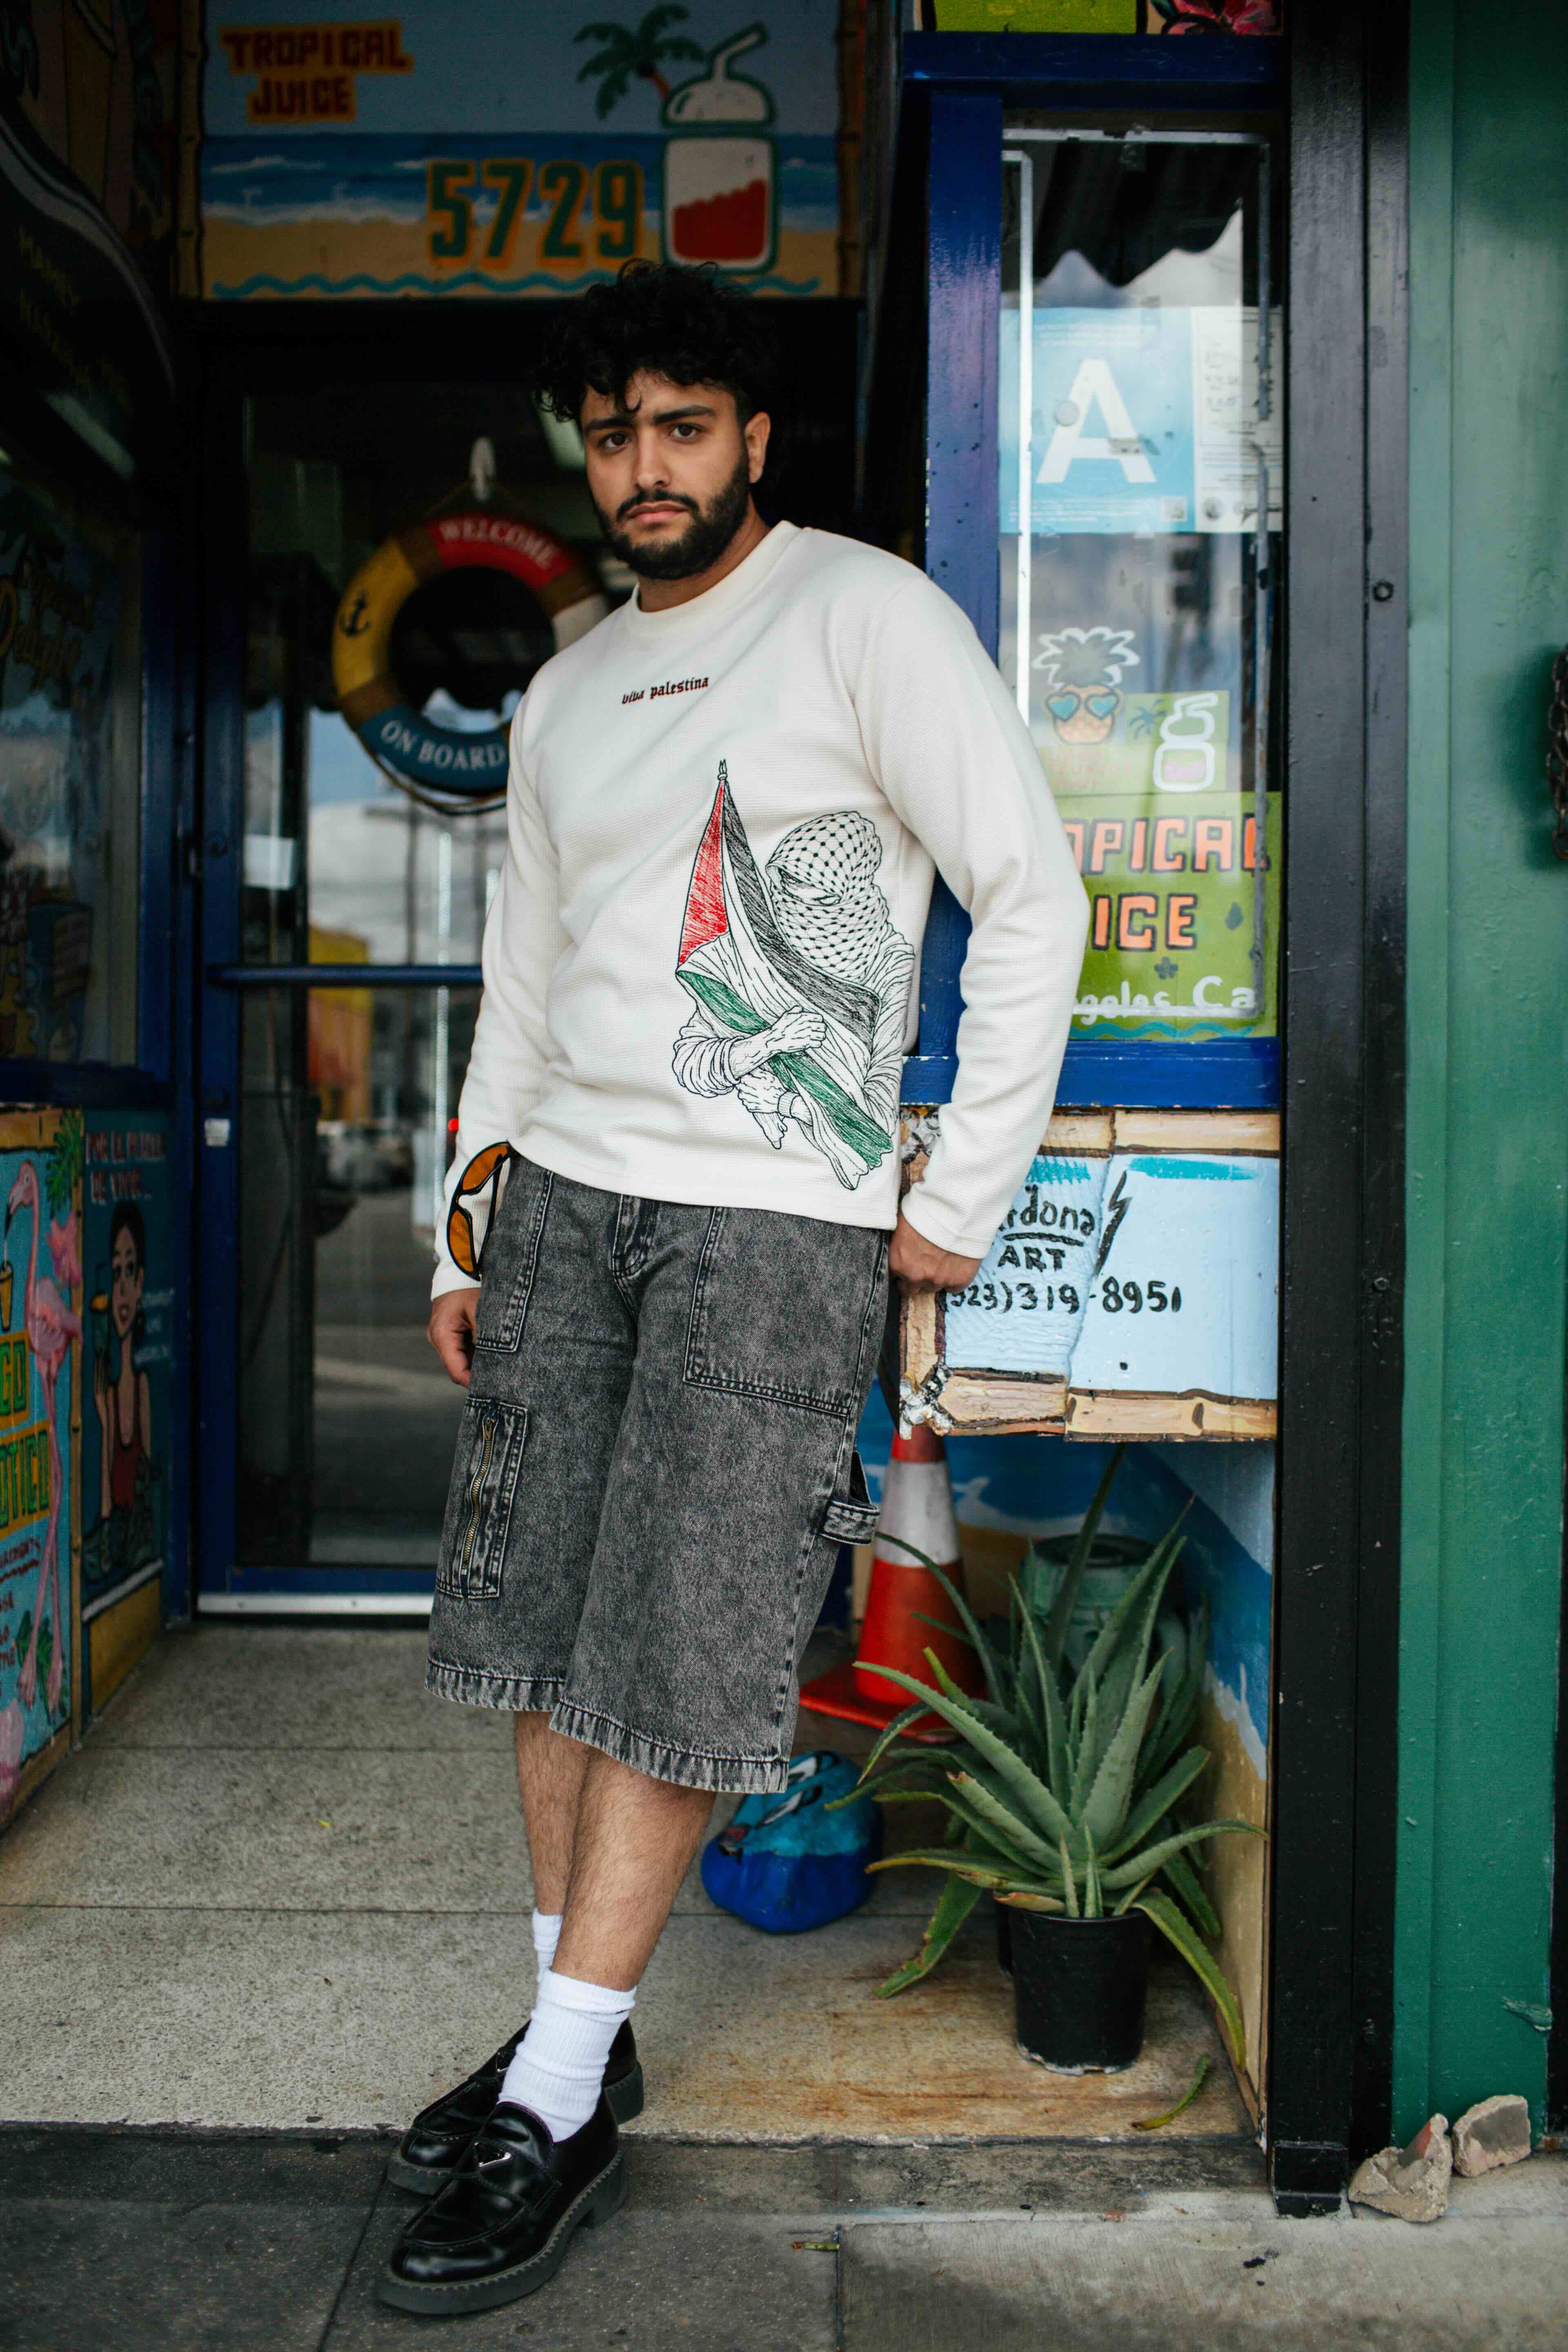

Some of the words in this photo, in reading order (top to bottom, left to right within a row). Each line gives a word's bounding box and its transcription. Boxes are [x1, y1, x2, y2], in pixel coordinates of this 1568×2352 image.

[222, 28, 407, 68] TROPICAL
[252, 75, 350, 115] JUICE
[429, 158, 644, 267] 5729
[1036, 359, 1157, 483] A
[439, 516, 559, 569] WELCOME
[621, 690, 645, 704] viva
[650, 676, 709, 699] palestina
[381, 719, 417, 754] ON
[418, 739, 507, 771] BOARD
[1075, 980, 1171, 1025] geles
[998, 1184, 1095, 1236] rdona
[998, 1245, 1066, 1272] ART
